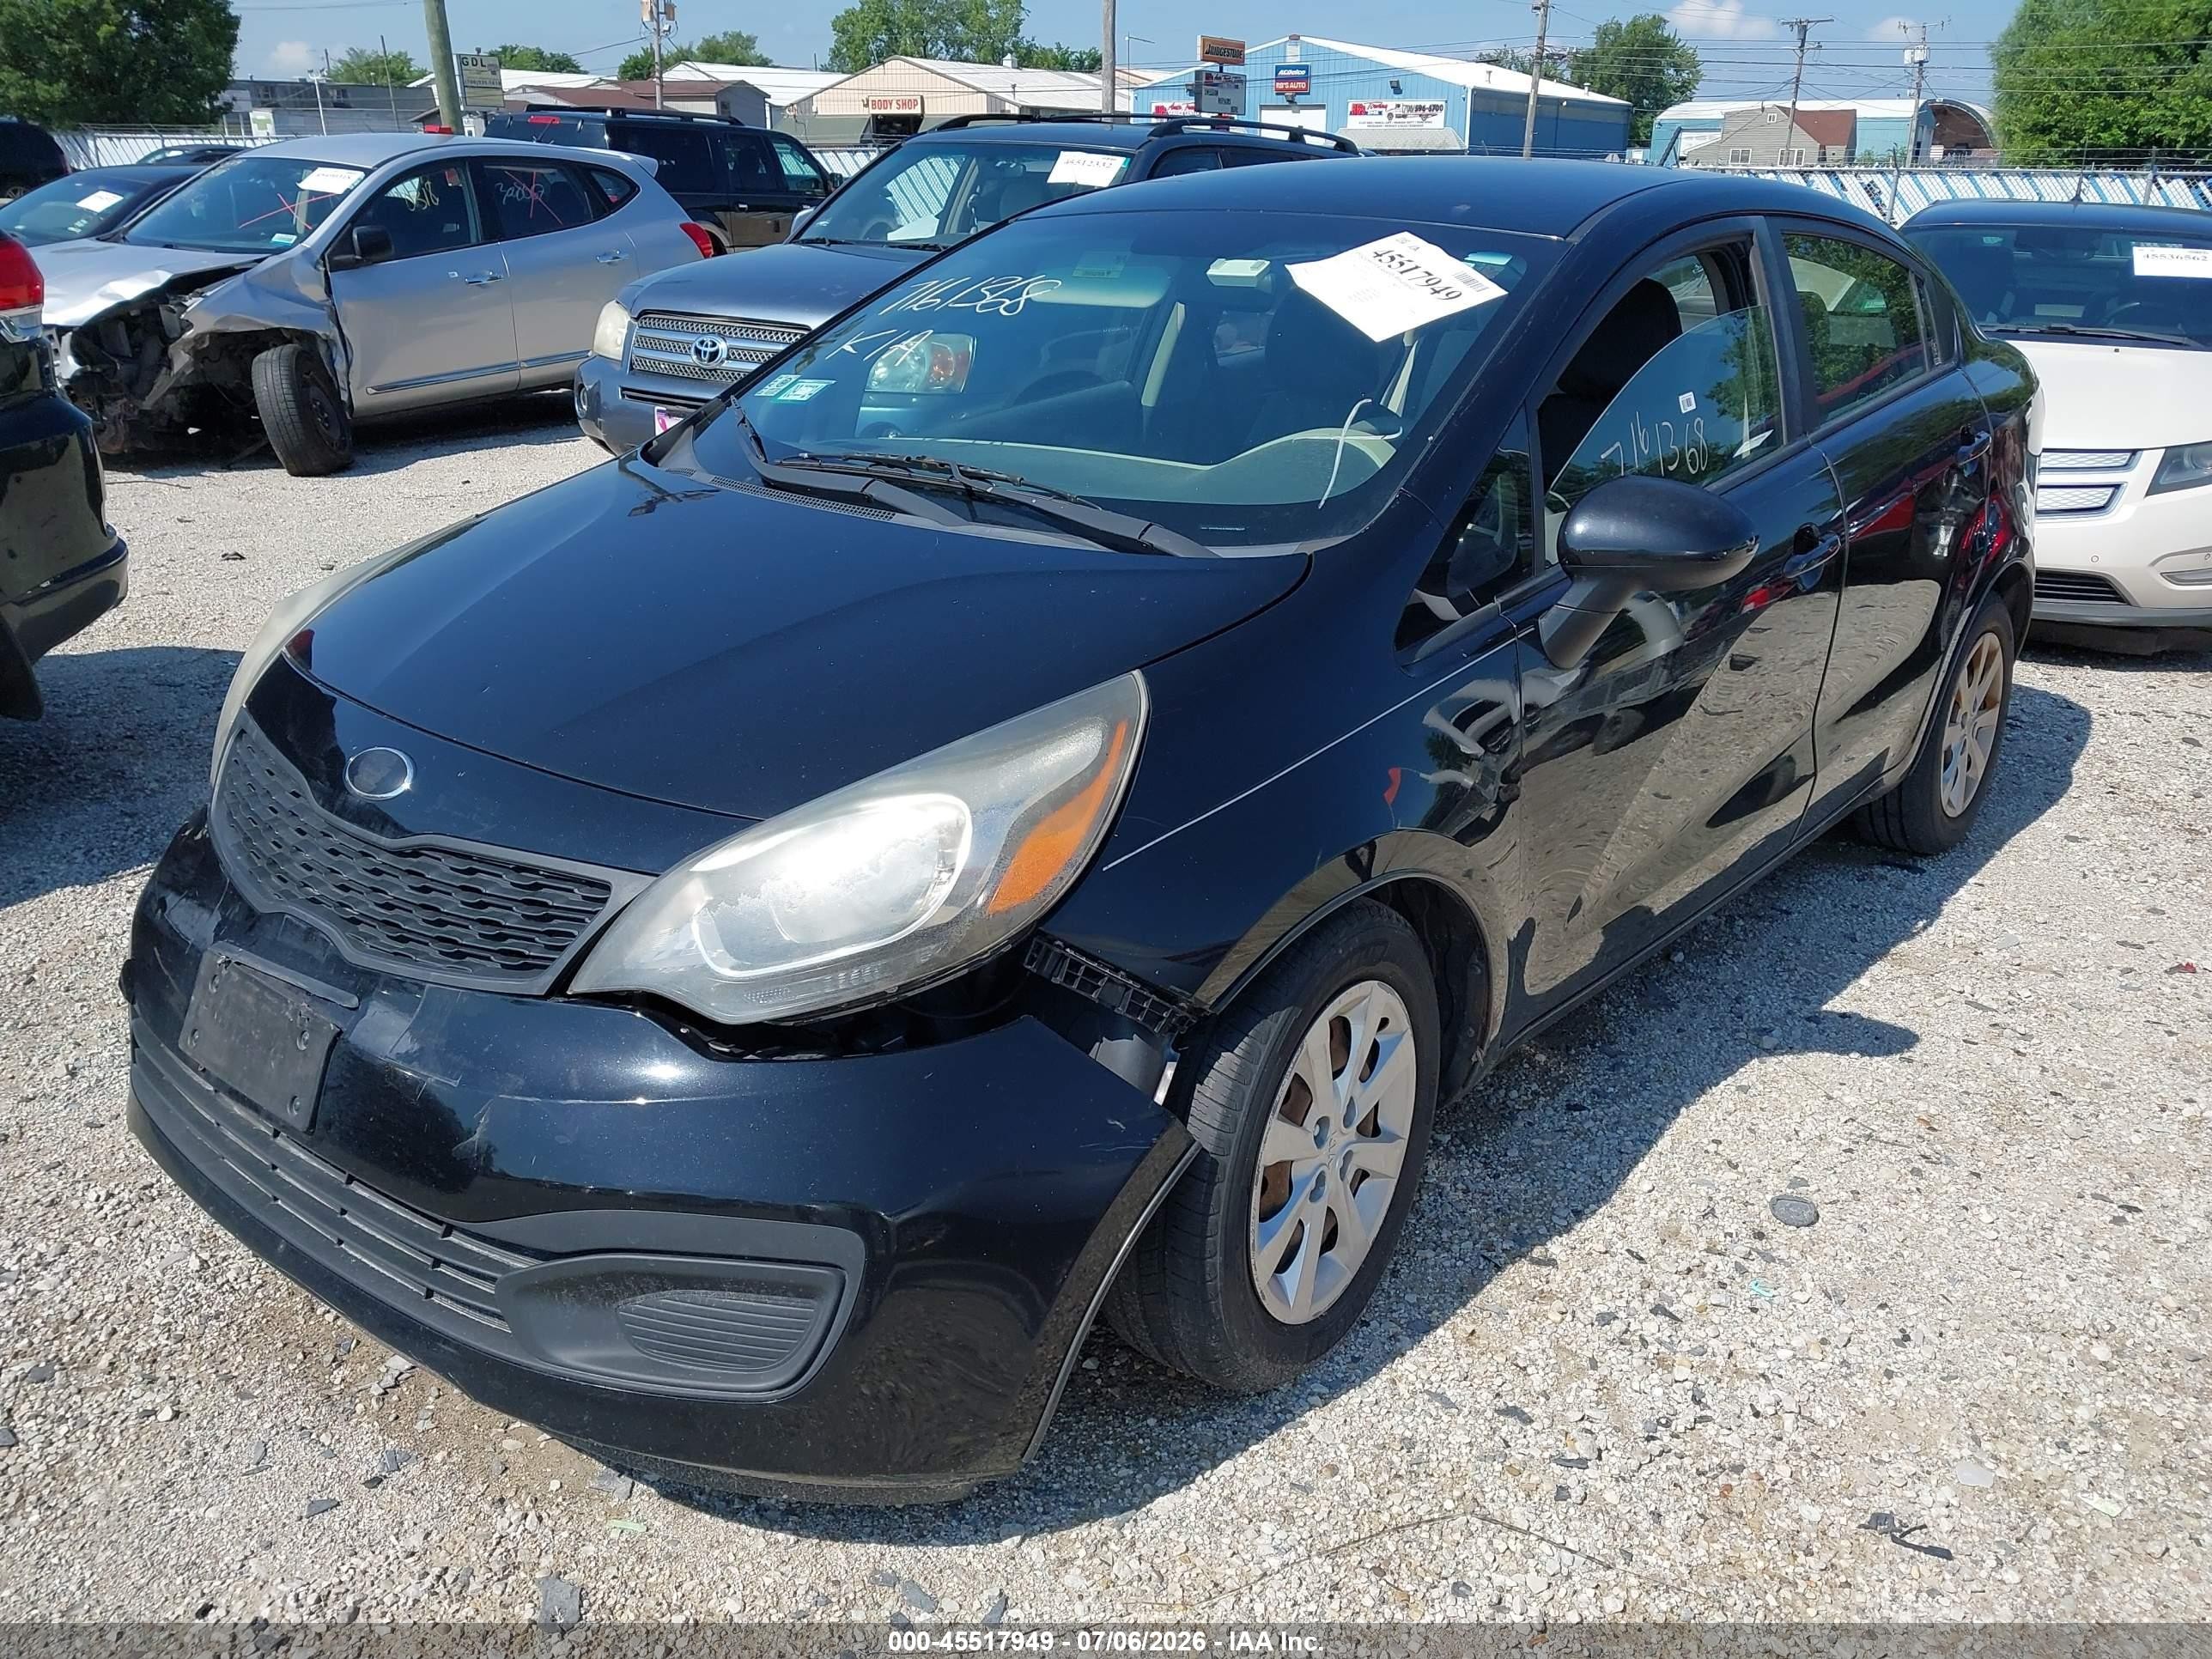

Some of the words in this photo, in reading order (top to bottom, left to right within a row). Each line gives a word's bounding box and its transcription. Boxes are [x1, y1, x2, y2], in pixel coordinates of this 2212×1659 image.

[1204, 44, 1243, 59] BRIDGESTONE
[461, 57, 486, 68] GDL
[871, 99, 893, 110] BODY
[896, 99, 918, 110] SHOP
[1373, 250, 1462, 301] 45517949
[825, 329, 934, 367] KIA
